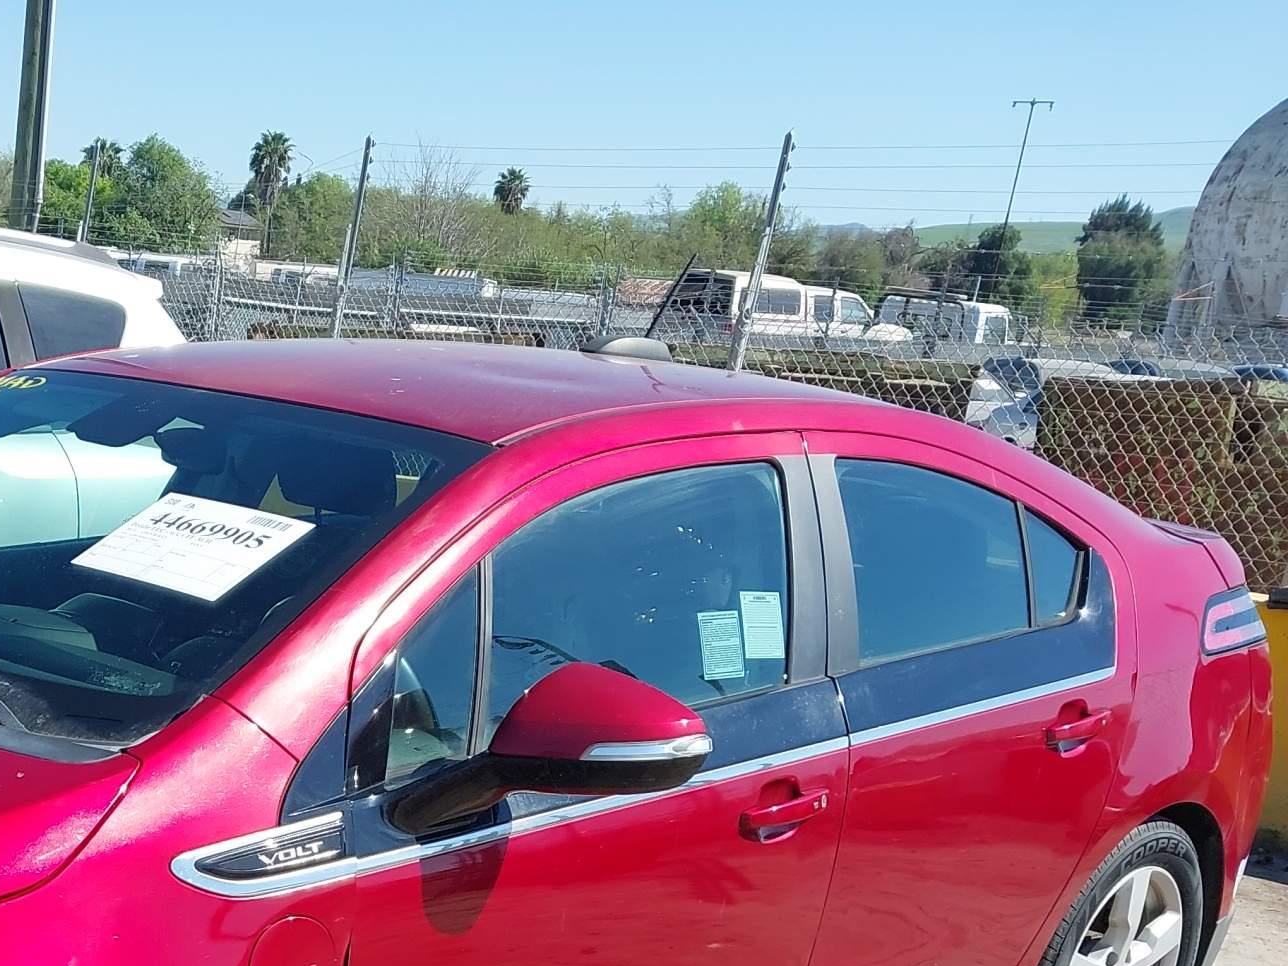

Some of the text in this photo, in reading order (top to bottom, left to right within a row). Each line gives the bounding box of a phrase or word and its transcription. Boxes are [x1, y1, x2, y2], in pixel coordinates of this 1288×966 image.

[149, 512, 273, 549] 44669905
[258, 841, 324, 865] VOLT
[1119, 838, 1188, 874] COOPER
